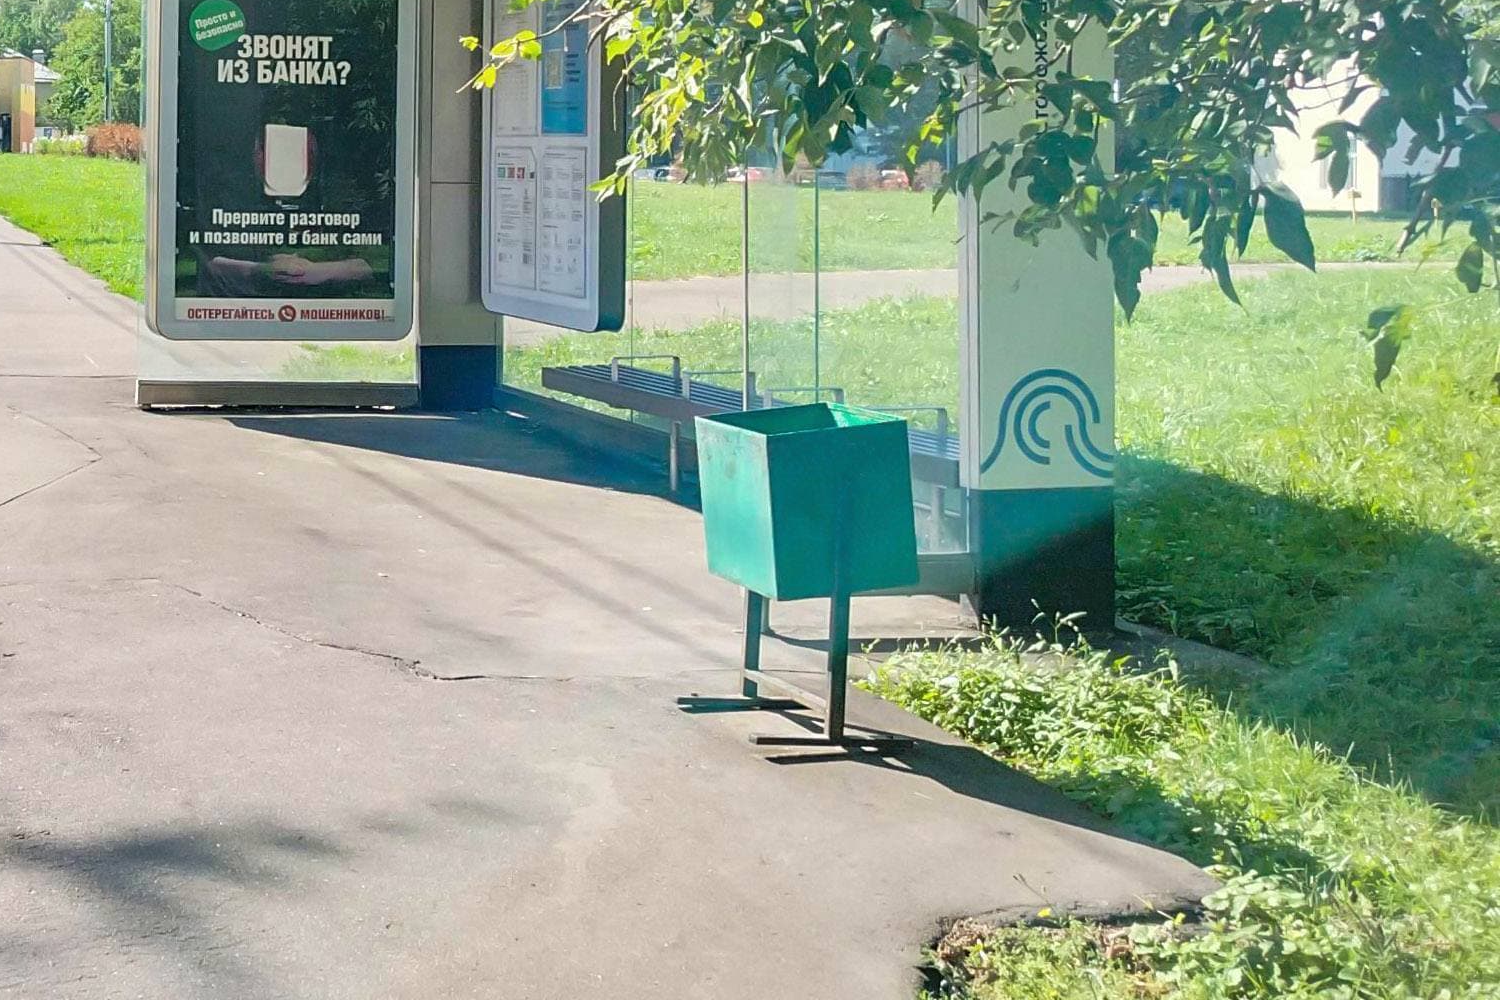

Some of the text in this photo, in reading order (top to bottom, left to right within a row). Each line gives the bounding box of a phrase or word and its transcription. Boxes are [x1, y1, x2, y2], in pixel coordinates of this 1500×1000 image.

[194, 10, 237, 29] Просто и
[195, 20, 244, 41] безопасно
[237, 34, 333, 60] ЗВОНЯТ
[217, 59, 351, 85] ИЗ БАНКА?
[212, 208, 360, 229] Прервите разговор
[189, 230, 382, 246] и позвоните в банк сами
[187, 306, 275, 320] ОСТЕРЕГАЙТЕСЬ
[301, 308, 385, 321] МОШЕННИКОВ!
